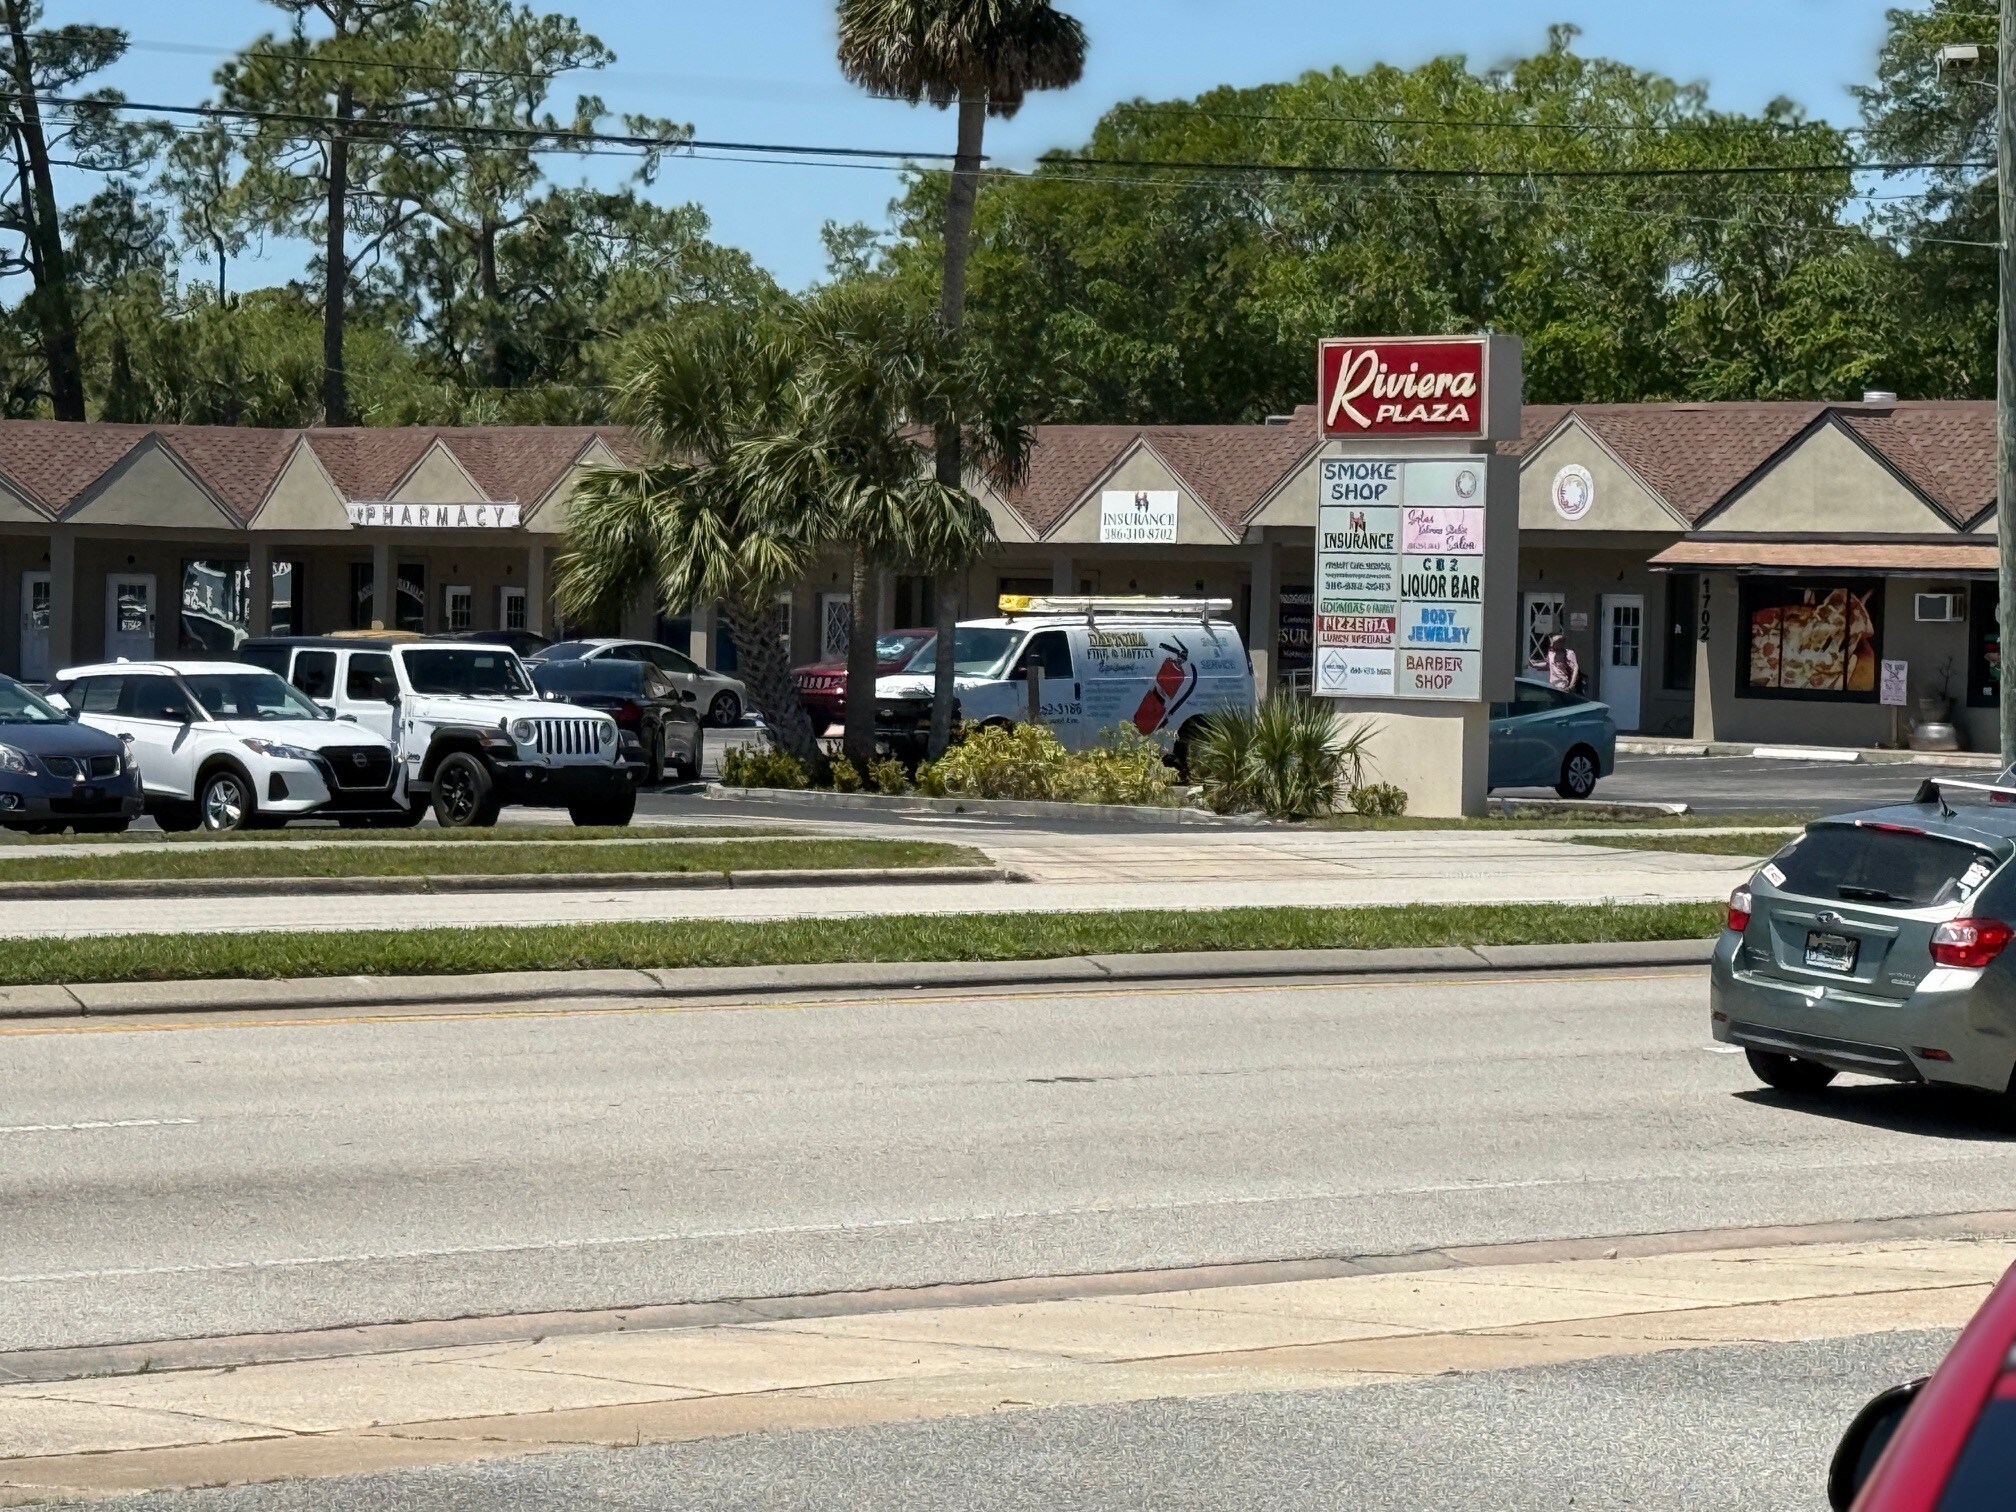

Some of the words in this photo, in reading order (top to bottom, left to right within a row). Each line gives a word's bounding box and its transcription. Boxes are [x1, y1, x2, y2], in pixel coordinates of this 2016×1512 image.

[1327, 349, 1476, 428] Riviera
[1375, 403, 1470, 423] PLAZA
[1324, 463, 1397, 480] SMOKE
[1331, 483, 1388, 500] SHOP
[366, 506, 505, 527] PHARMACY
[1104, 512, 1175, 526] INSURANCE
[1324, 532, 1394, 550] INSURANCE
[1400, 573, 1447, 598] LIQUOR
[1451, 574, 1480, 599] BAR
[1422, 608, 1457, 626] BODY
[1701, 577, 1711, 642] 1702
[1323, 617, 1390, 632] PIZZERIA
[1407, 625, 1470, 644] JEWELRY
[1406, 655, 1463, 672] BARBER
[1415, 674, 1453, 690] SHOP
